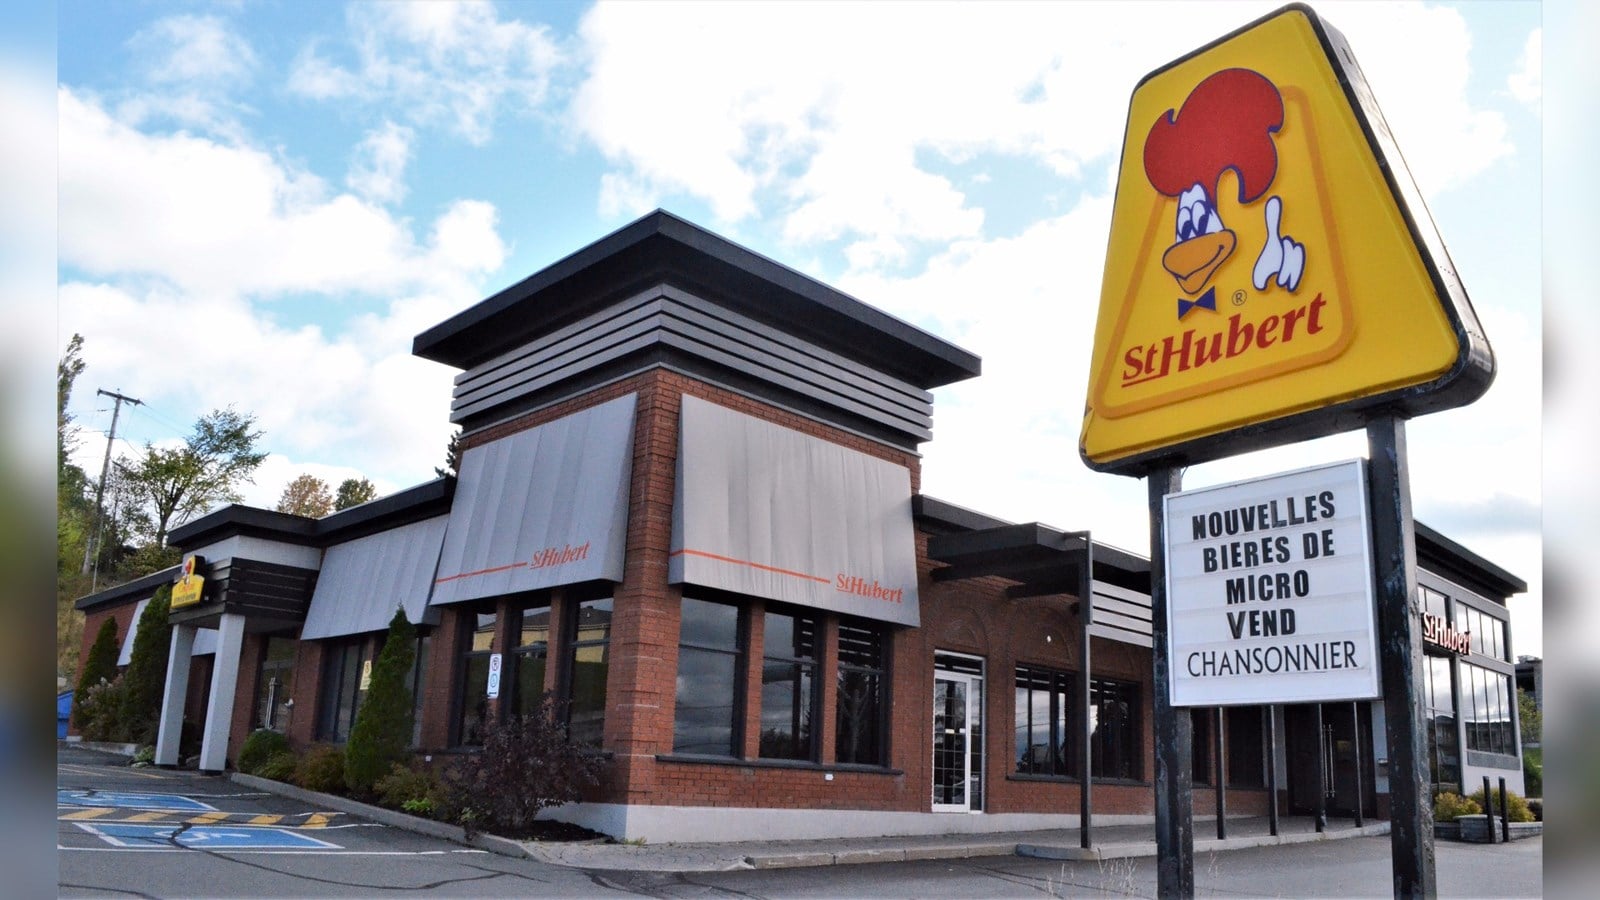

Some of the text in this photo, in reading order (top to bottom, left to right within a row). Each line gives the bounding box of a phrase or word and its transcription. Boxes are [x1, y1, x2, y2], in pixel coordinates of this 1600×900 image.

[1192, 491, 1335, 540] NOUVELLES
[1203, 529, 1335, 573] BIERES DE
[1226, 569, 1309, 605] MICRO
[1226, 608, 1296, 640] VEND
[1187, 640, 1358, 678] CHANSONNIER
